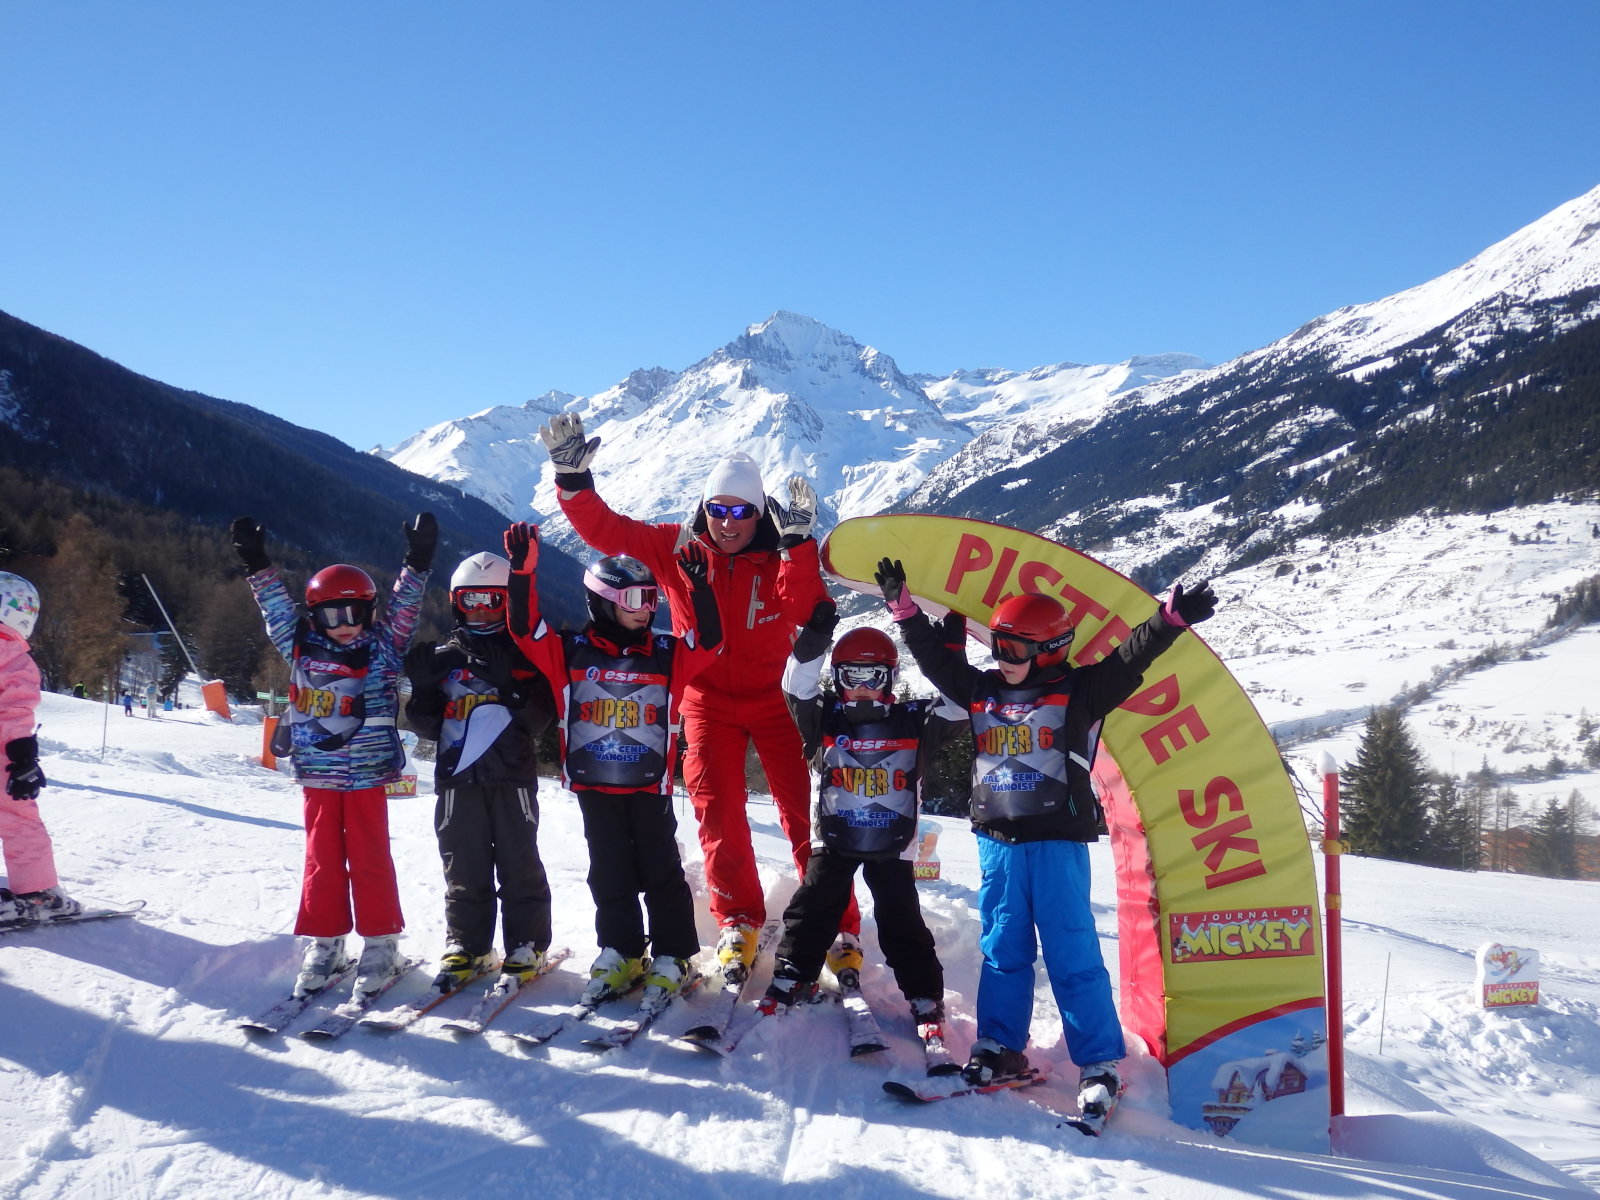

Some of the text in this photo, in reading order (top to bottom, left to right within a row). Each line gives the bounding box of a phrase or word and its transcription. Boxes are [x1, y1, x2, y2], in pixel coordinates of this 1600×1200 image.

[604, 670, 639, 681] esf
[340, 695, 353, 716] 6
[443, 694, 499, 721] SUP
[580, 698, 657, 728] SUPER 6
[852, 740, 886, 750] esf
[977, 724, 1054, 756] SUPER 6
[595, 753, 641, 763] VANOISE
[831, 767, 907, 798] SUPER 6
[1012, 772, 1044, 782] CENIS
[1117, 673, 1210, 766] DE
[1178, 775, 1267, 890] SKI
[990, 782, 1035, 792] VANOISE
[847, 819, 890, 829] VANOISE
[915, 865, 939, 878] KEY
[1173, 908, 1310, 924] LE JOURNAL DE
[1181, 917, 1311, 957] MICKEY
[1488, 987, 1537, 1004] MICKEY
